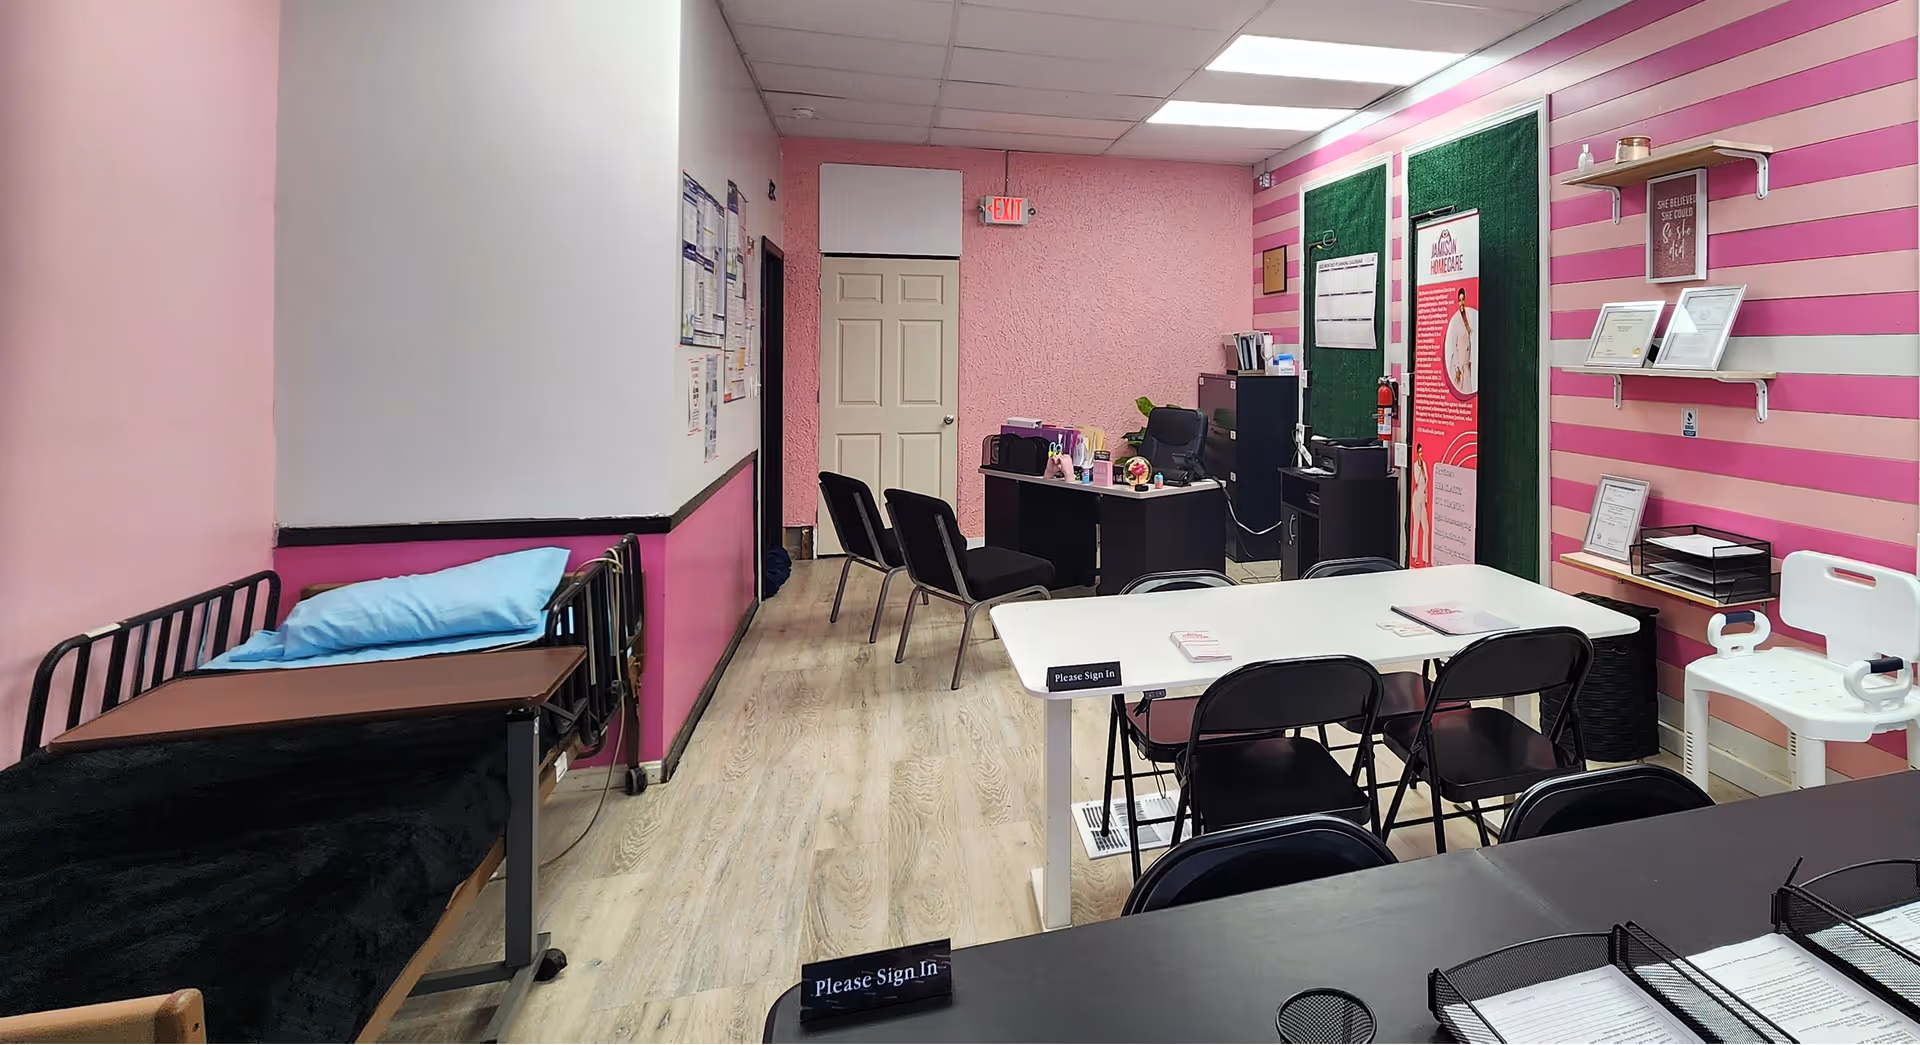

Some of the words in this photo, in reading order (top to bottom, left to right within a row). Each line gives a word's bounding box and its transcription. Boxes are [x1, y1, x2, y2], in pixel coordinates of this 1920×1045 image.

[993, 197, 1023, 221] EXIT
[1657, 197, 1669, 210] SHE
[1661, 210, 1673, 221] SHE
[1674, 207, 1693, 220] COULD
[1662, 222, 1673, 244] So
[1676, 219, 1692, 240] she
[1431, 237, 1457, 259] JAMISON
[1669, 237, 1686, 262] did
[1430, 254, 1463, 275] HOMECARE
[1055, 672, 1083, 683] Please
[1084, 671, 1104, 681] Sign
[1105, 669, 1115, 678] In
[815, 975, 872, 997] Please
[877, 966, 915, 986] Sign
[919, 960, 938, 978] In
